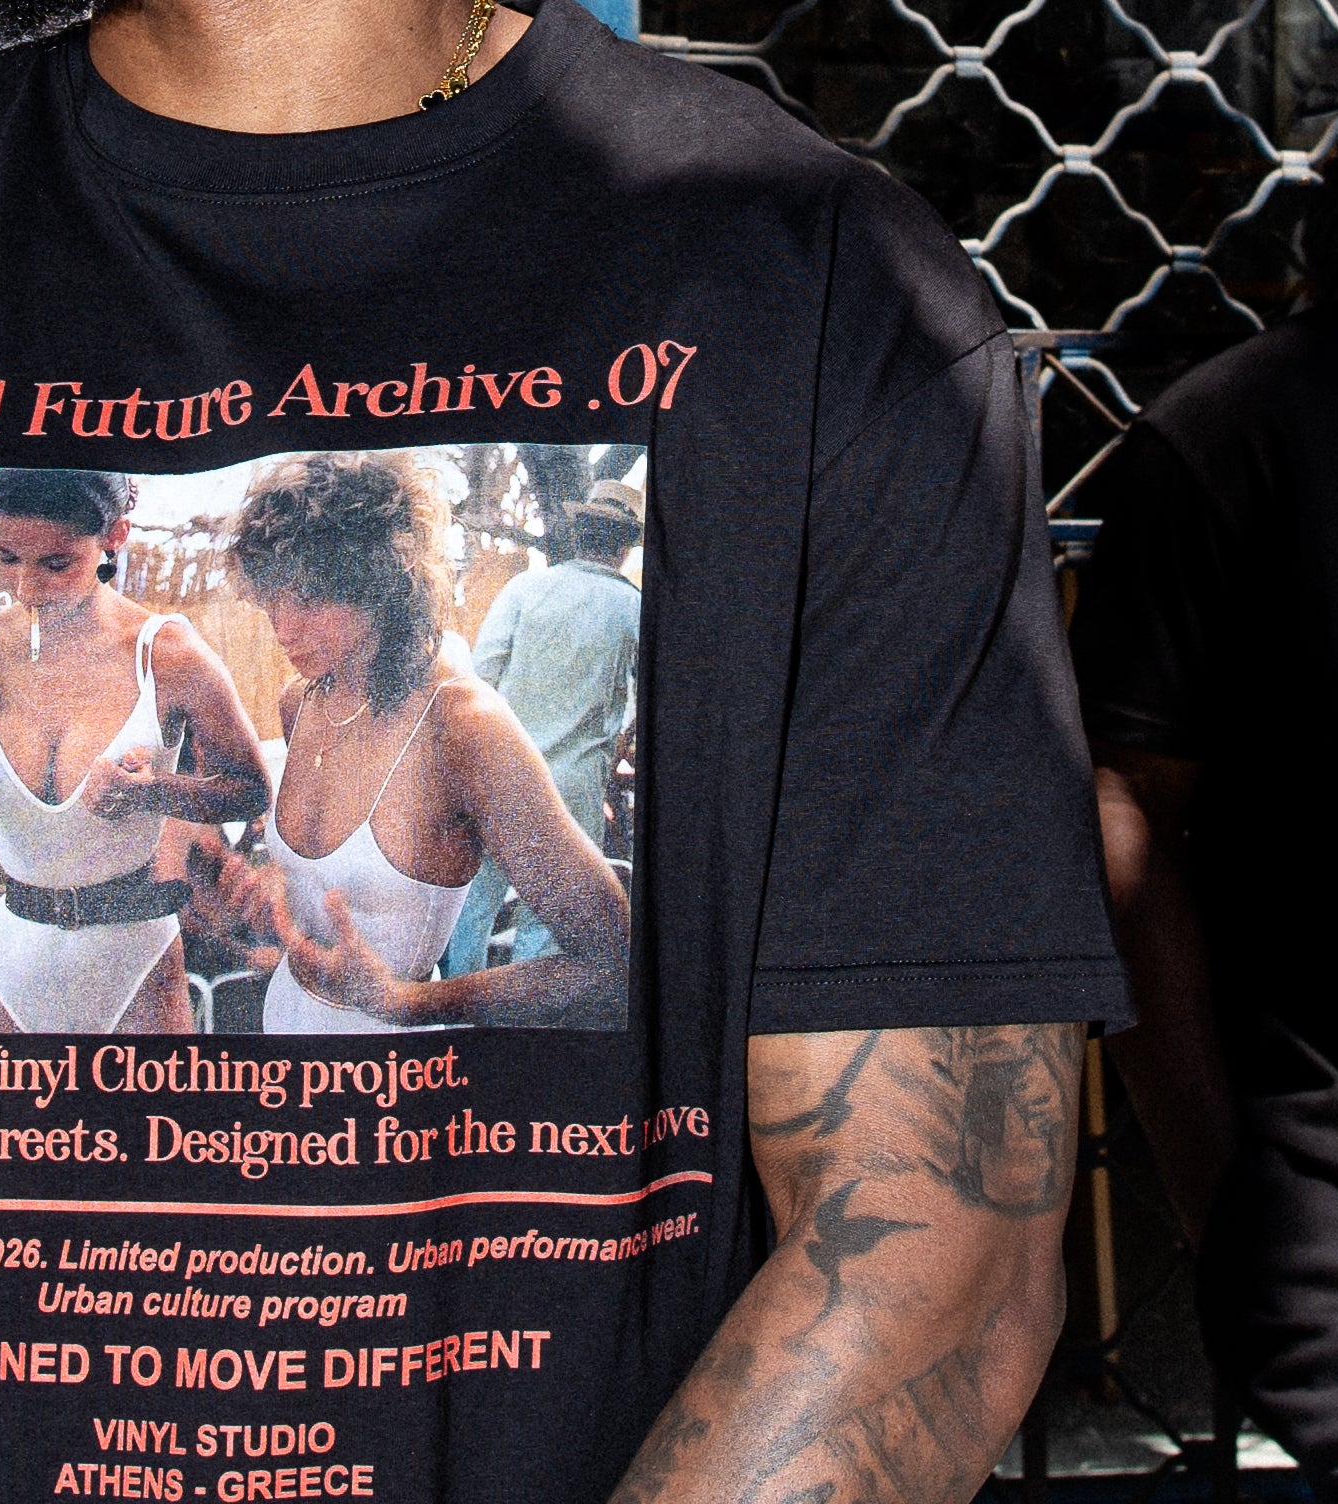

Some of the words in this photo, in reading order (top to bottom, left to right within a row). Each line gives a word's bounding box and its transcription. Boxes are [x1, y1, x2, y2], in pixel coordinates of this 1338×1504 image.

[25, 381, 253, 442] Future
[268, 363, 562, 418] Archive
[588, 340, 697, 410] .07
[92, 1045, 291, 1108] Clothing
[301, 1045, 469, 1109] project.
[146, 1112, 357, 1178] Designed
[375, 1110, 441, 1164] for
[446, 1108, 516, 1157] the
[529, 1114, 636, 1156] next
[58, 1240, 181, 1274] Limited
[185, 1244, 375, 1282] production.
[387, 1240, 464, 1275] Urban
[467, 1230, 648, 1269] performance
[651, 1212, 699, 1246] wear.
[37, 1283, 134, 1316] Urban
[142, 1286, 252, 1320] culture
[258, 1292, 408, 1328] program
[104, 1345, 163, 1388] TO
[174, 1348, 307, 1391] MOVE
[321, 1329, 552, 1389] DIFFERENT
[93, 1418, 187, 1456] VINYL
[195, 1423, 336, 1458] STUDIO
[54, 1462, 184, 1503] ATHENS
[216, 1465, 374, 1504] GREECE
